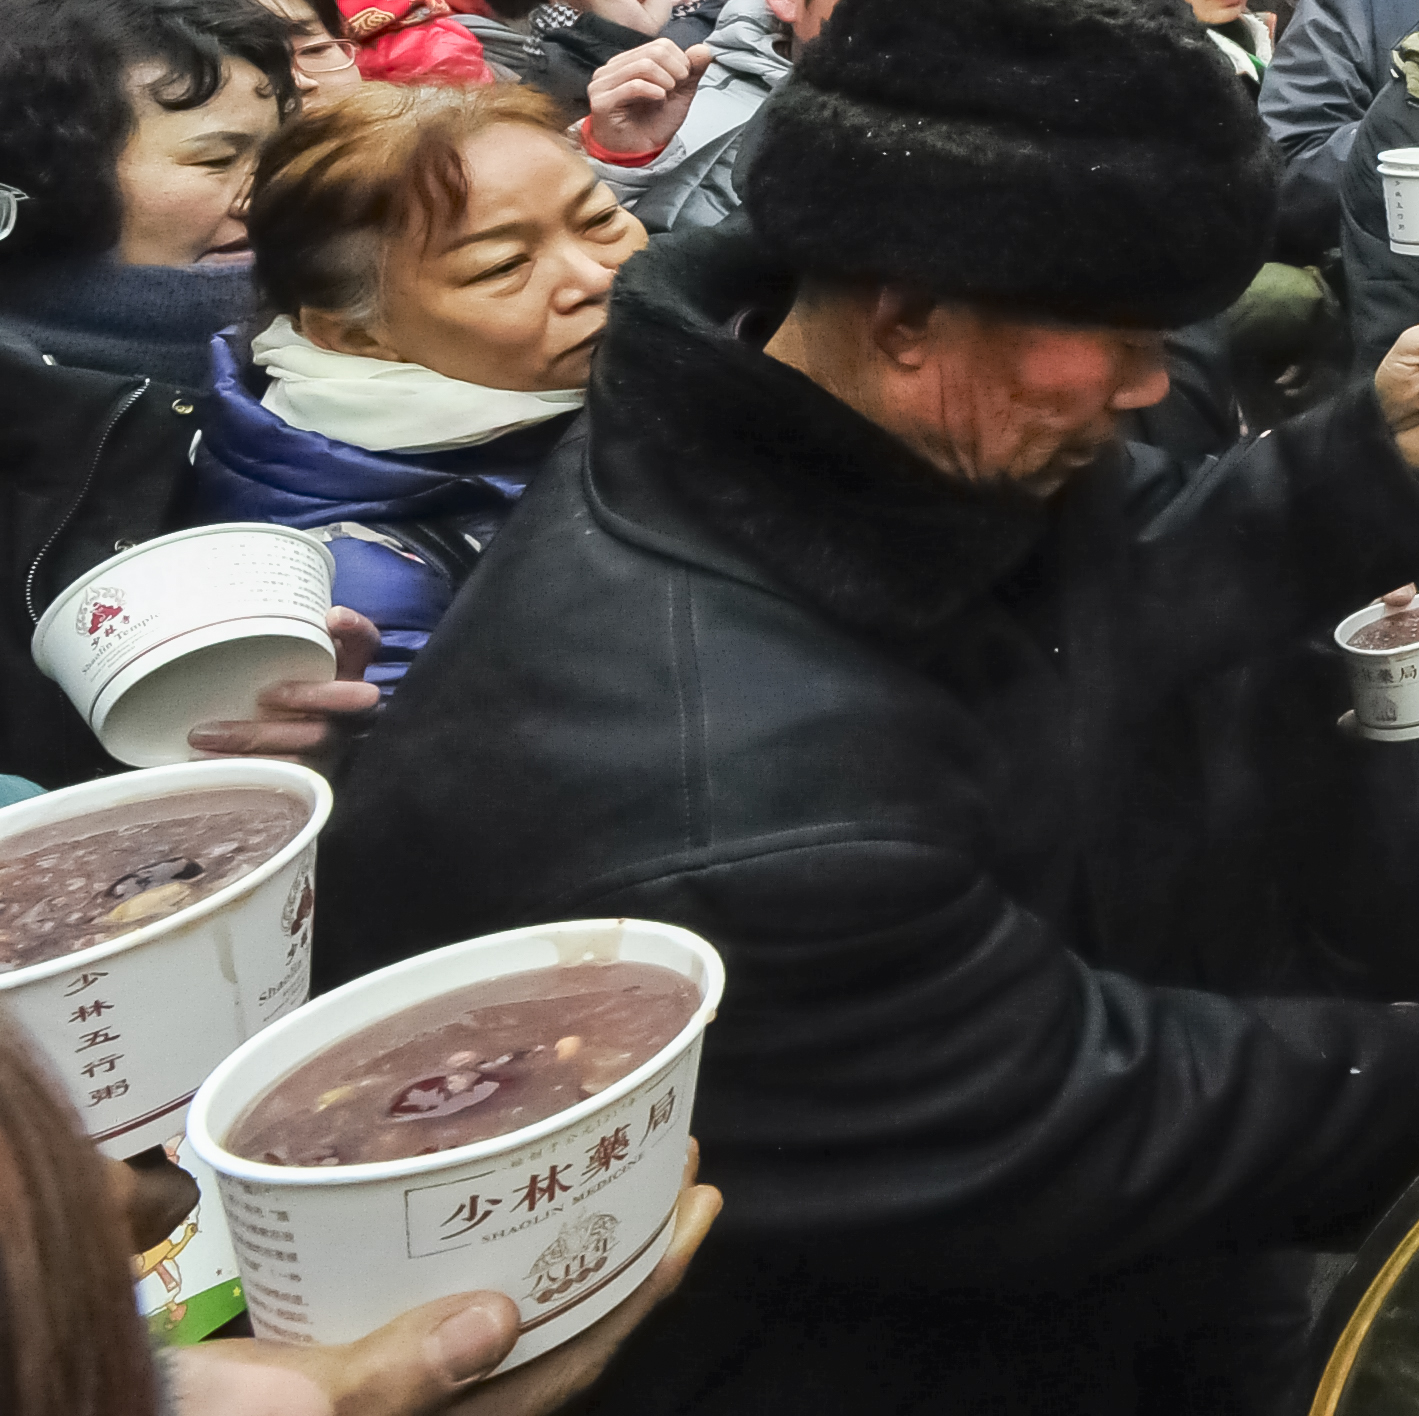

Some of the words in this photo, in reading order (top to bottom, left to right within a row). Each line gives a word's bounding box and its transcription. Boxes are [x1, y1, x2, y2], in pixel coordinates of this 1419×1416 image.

[63, 971, 131, 1108] 少林五行粥
[439, 1086, 677, 1242] 少林藥局
[481, 1203, 565, 1244] SHAOLIN
[571, 1150, 645, 1206] MEDICINE
